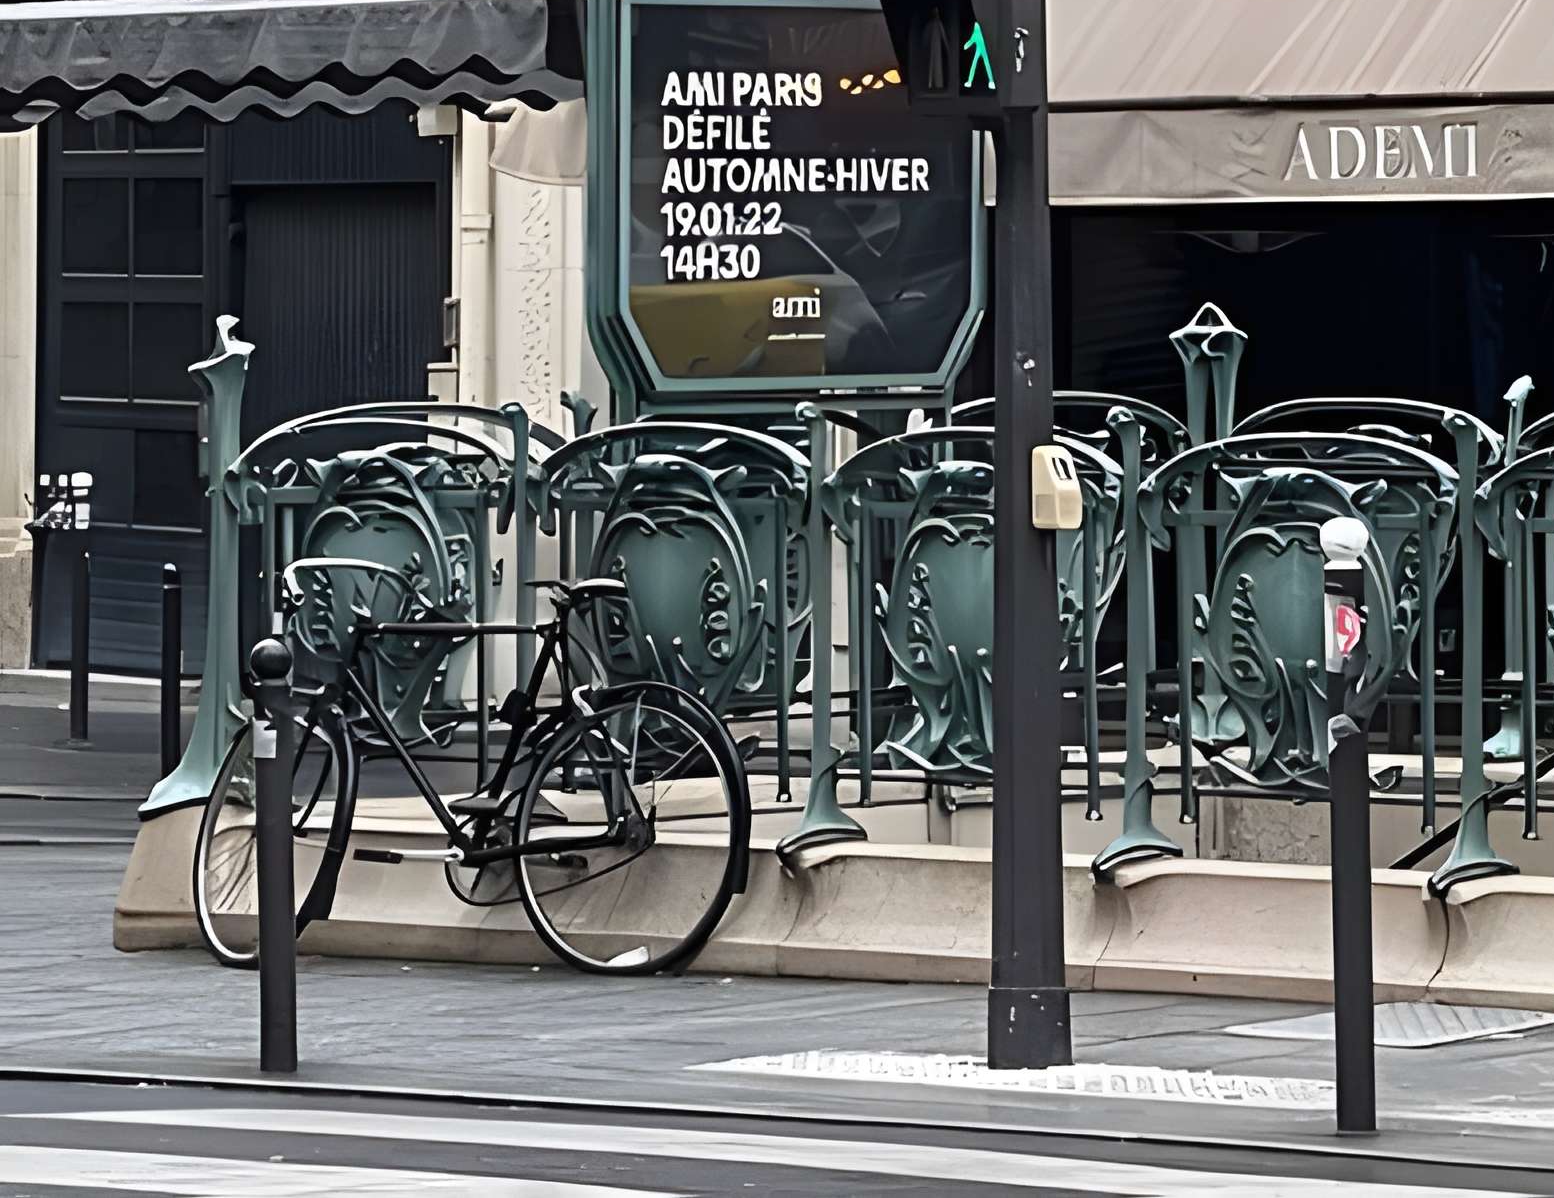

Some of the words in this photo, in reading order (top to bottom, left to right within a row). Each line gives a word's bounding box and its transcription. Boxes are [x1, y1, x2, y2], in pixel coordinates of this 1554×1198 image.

[660, 70, 725, 107] AMI
[732, 71, 823, 107] PARIS
[662, 107, 772, 150] DÉFILÉ
[660, 157, 930, 194] AUTOMNE-HIVER
[660, 201, 783, 237] 19.01.22
[772, 287, 821, 318] ami
